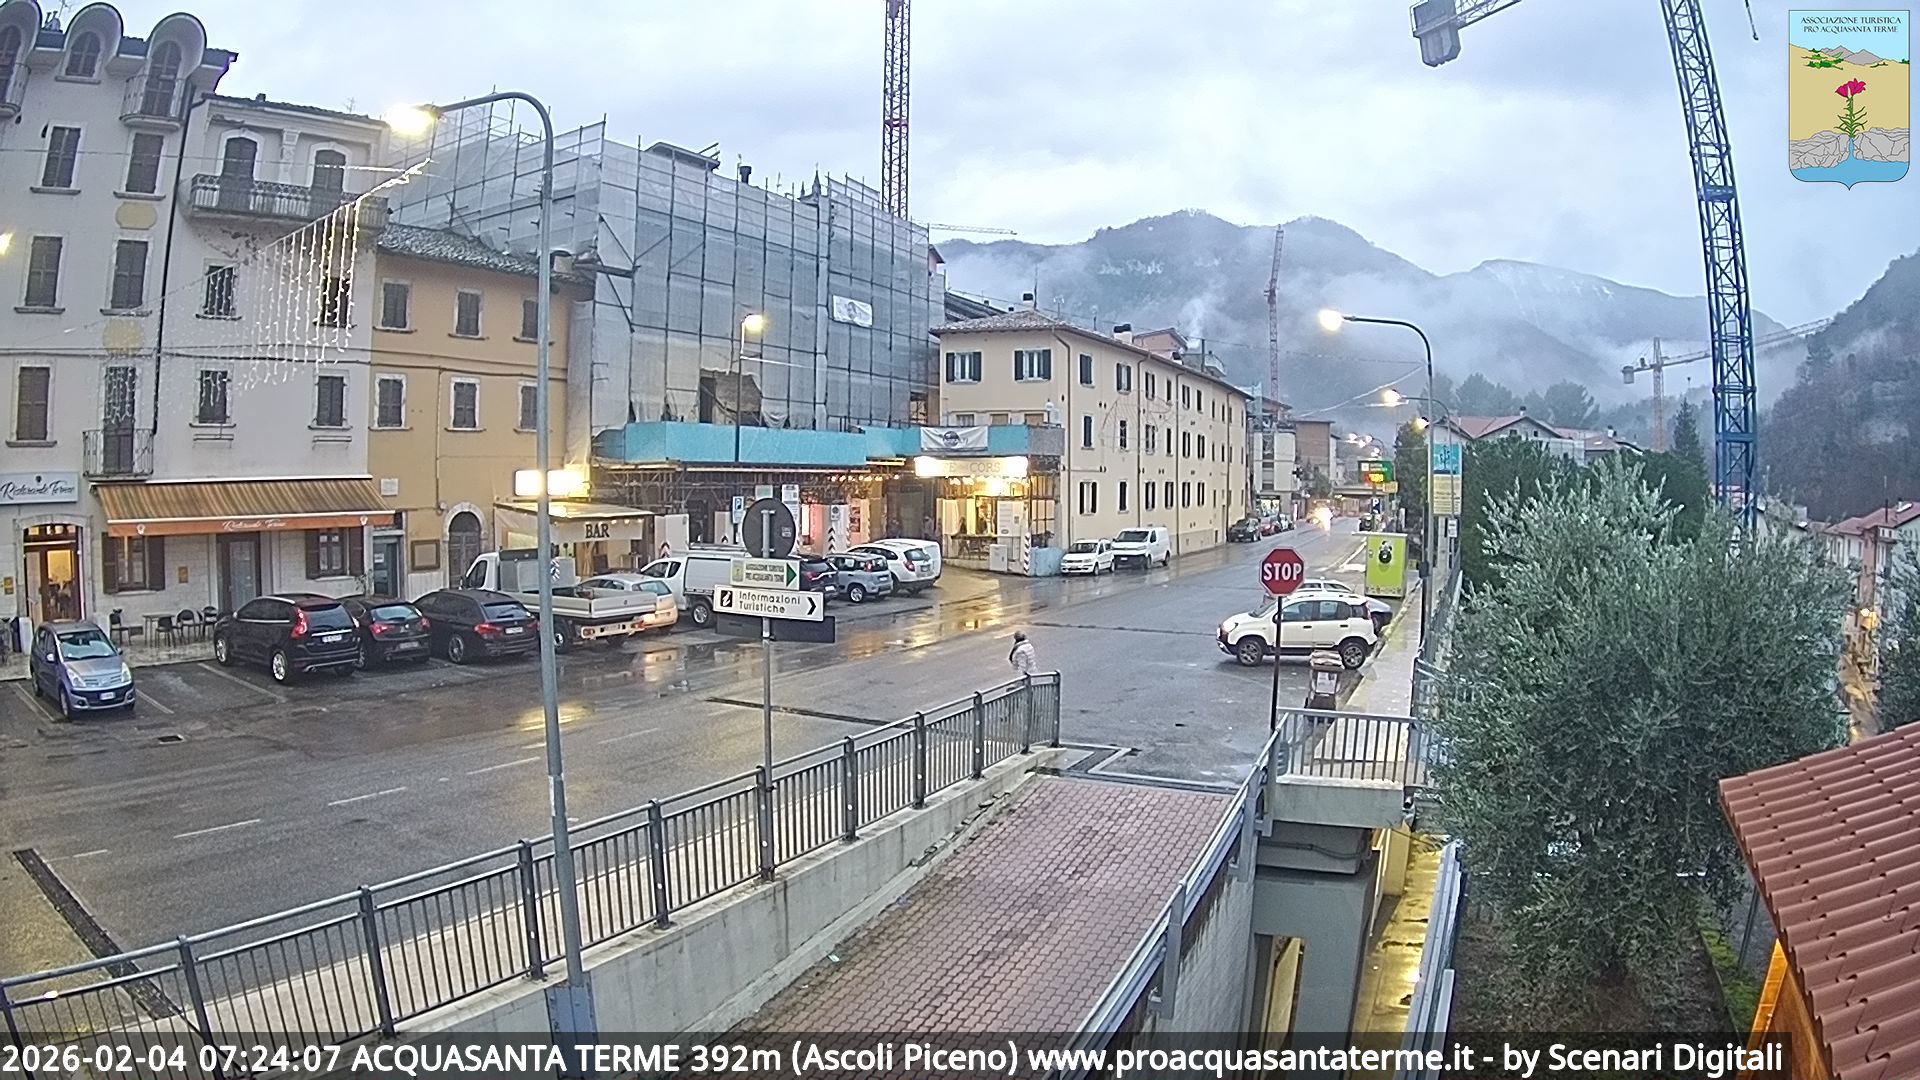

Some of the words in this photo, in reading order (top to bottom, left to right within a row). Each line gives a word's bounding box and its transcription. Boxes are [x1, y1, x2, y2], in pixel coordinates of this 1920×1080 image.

[969, 462, 1001, 473] CORS
[585, 523, 610, 539] BAR
[1263, 562, 1302, 581] STOP
[739, 591, 801, 605] Informazioni
[739, 600, 786, 614] Turistiche
